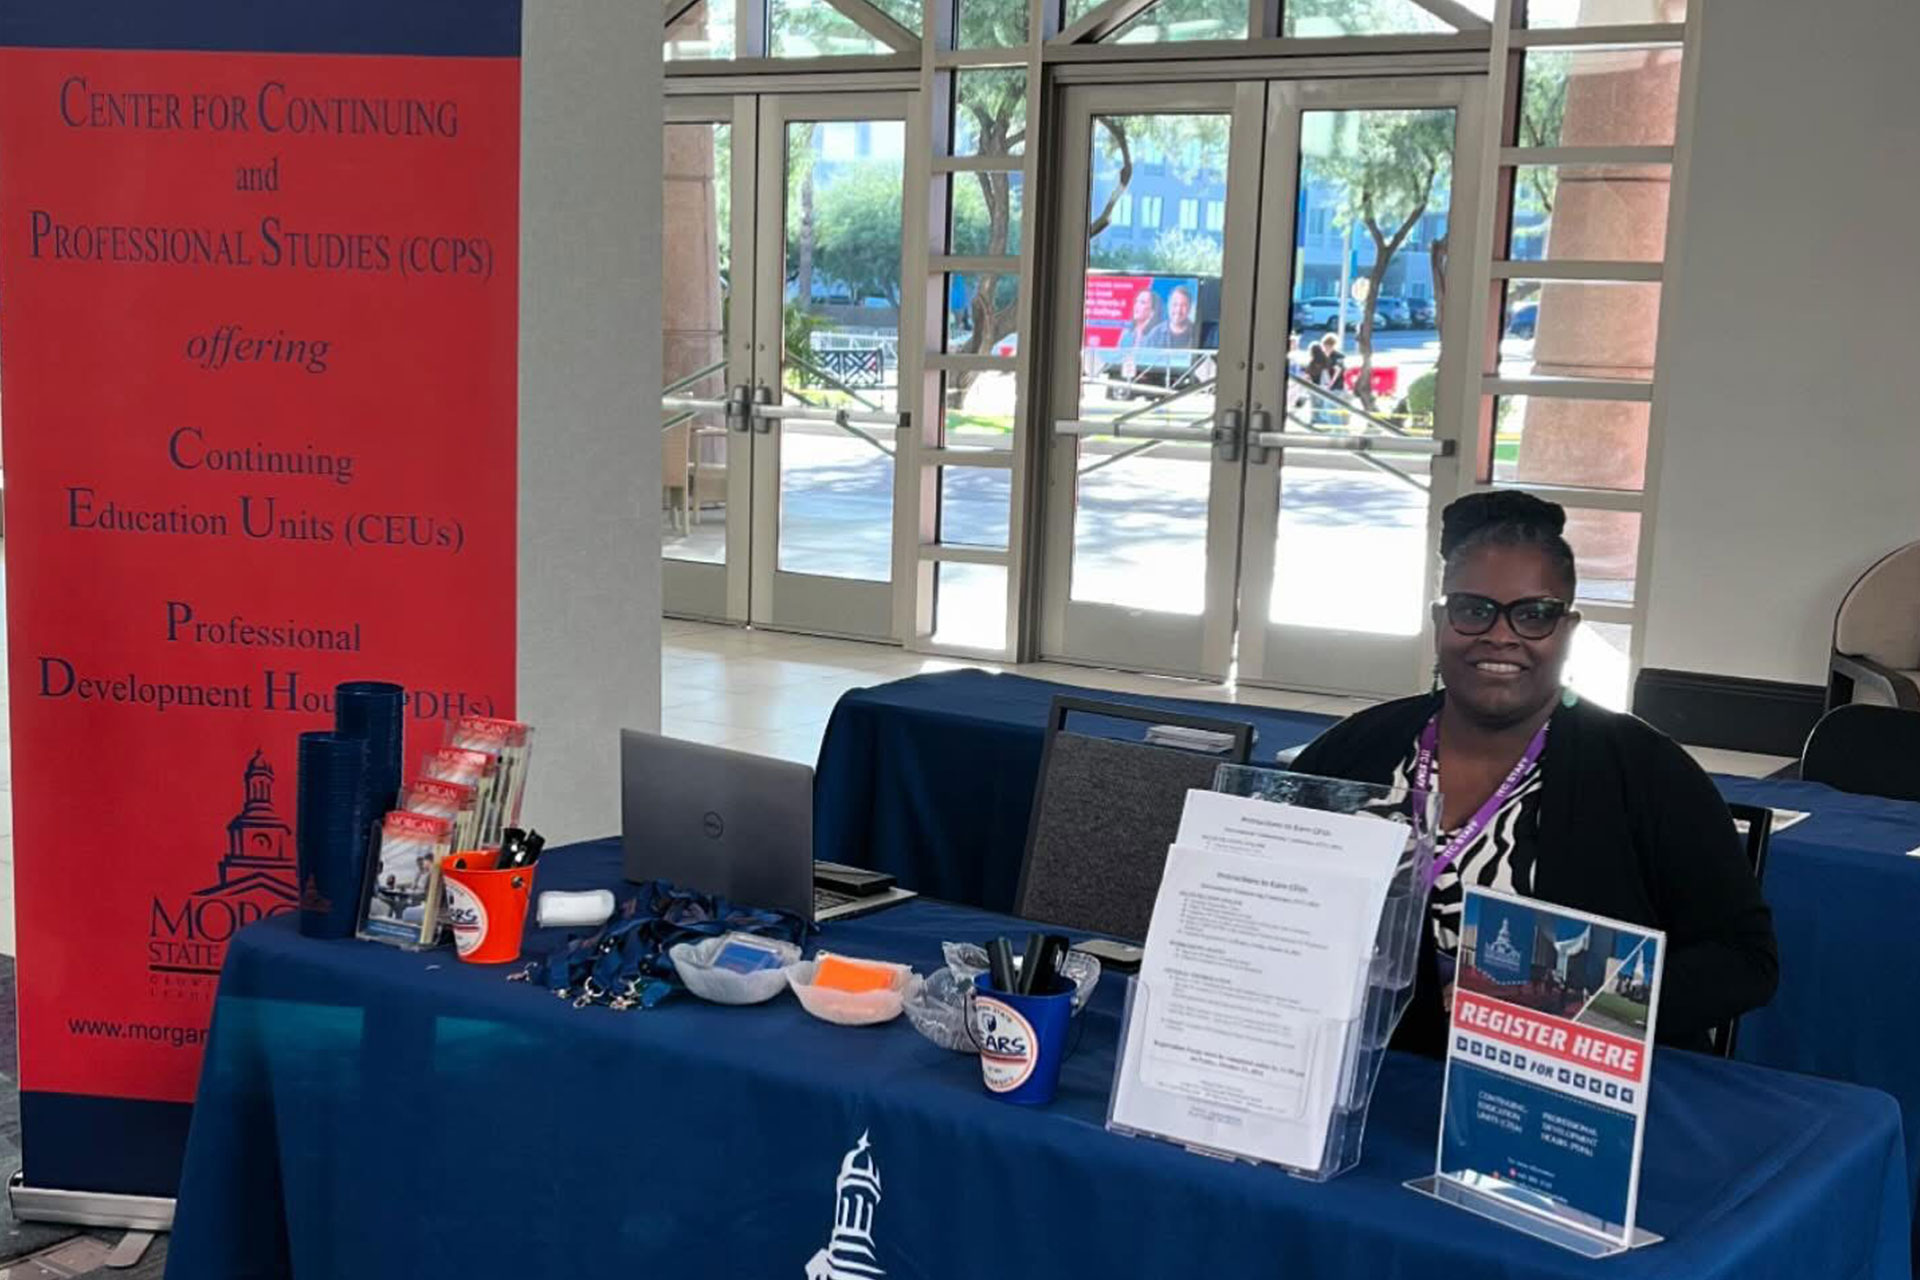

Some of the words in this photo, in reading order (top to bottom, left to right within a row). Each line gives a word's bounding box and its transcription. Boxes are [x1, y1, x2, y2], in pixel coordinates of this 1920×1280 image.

[59, 76, 183, 130] CENTER
[191, 94, 250, 133] FOR
[257, 81, 459, 138] CONTINUING
[235, 157, 280, 193] and
[29, 209, 253, 268] PROFESSIONAL
[260, 216, 391, 272] STUDIES
[399, 236, 495, 281] (CCPS)
[186, 325, 331, 374] offering
[168, 426, 355, 484] Continuing
[65, 487, 230, 537] Education
[239, 496, 335, 543] Units
[344, 514, 465, 554] (CEUs)
[166, 600, 361, 652] Professional
[38, 656, 252, 710] Development
[263, 669, 336, 714] Hou
[150, 896, 297, 942] MOR
[148, 941, 220, 967] STATE
[1460, 1001, 1568, 1051] REGISTER
[1572, 1031, 1638, 1072] HERE
[1530, 1061, 1554, 1078] FOR
